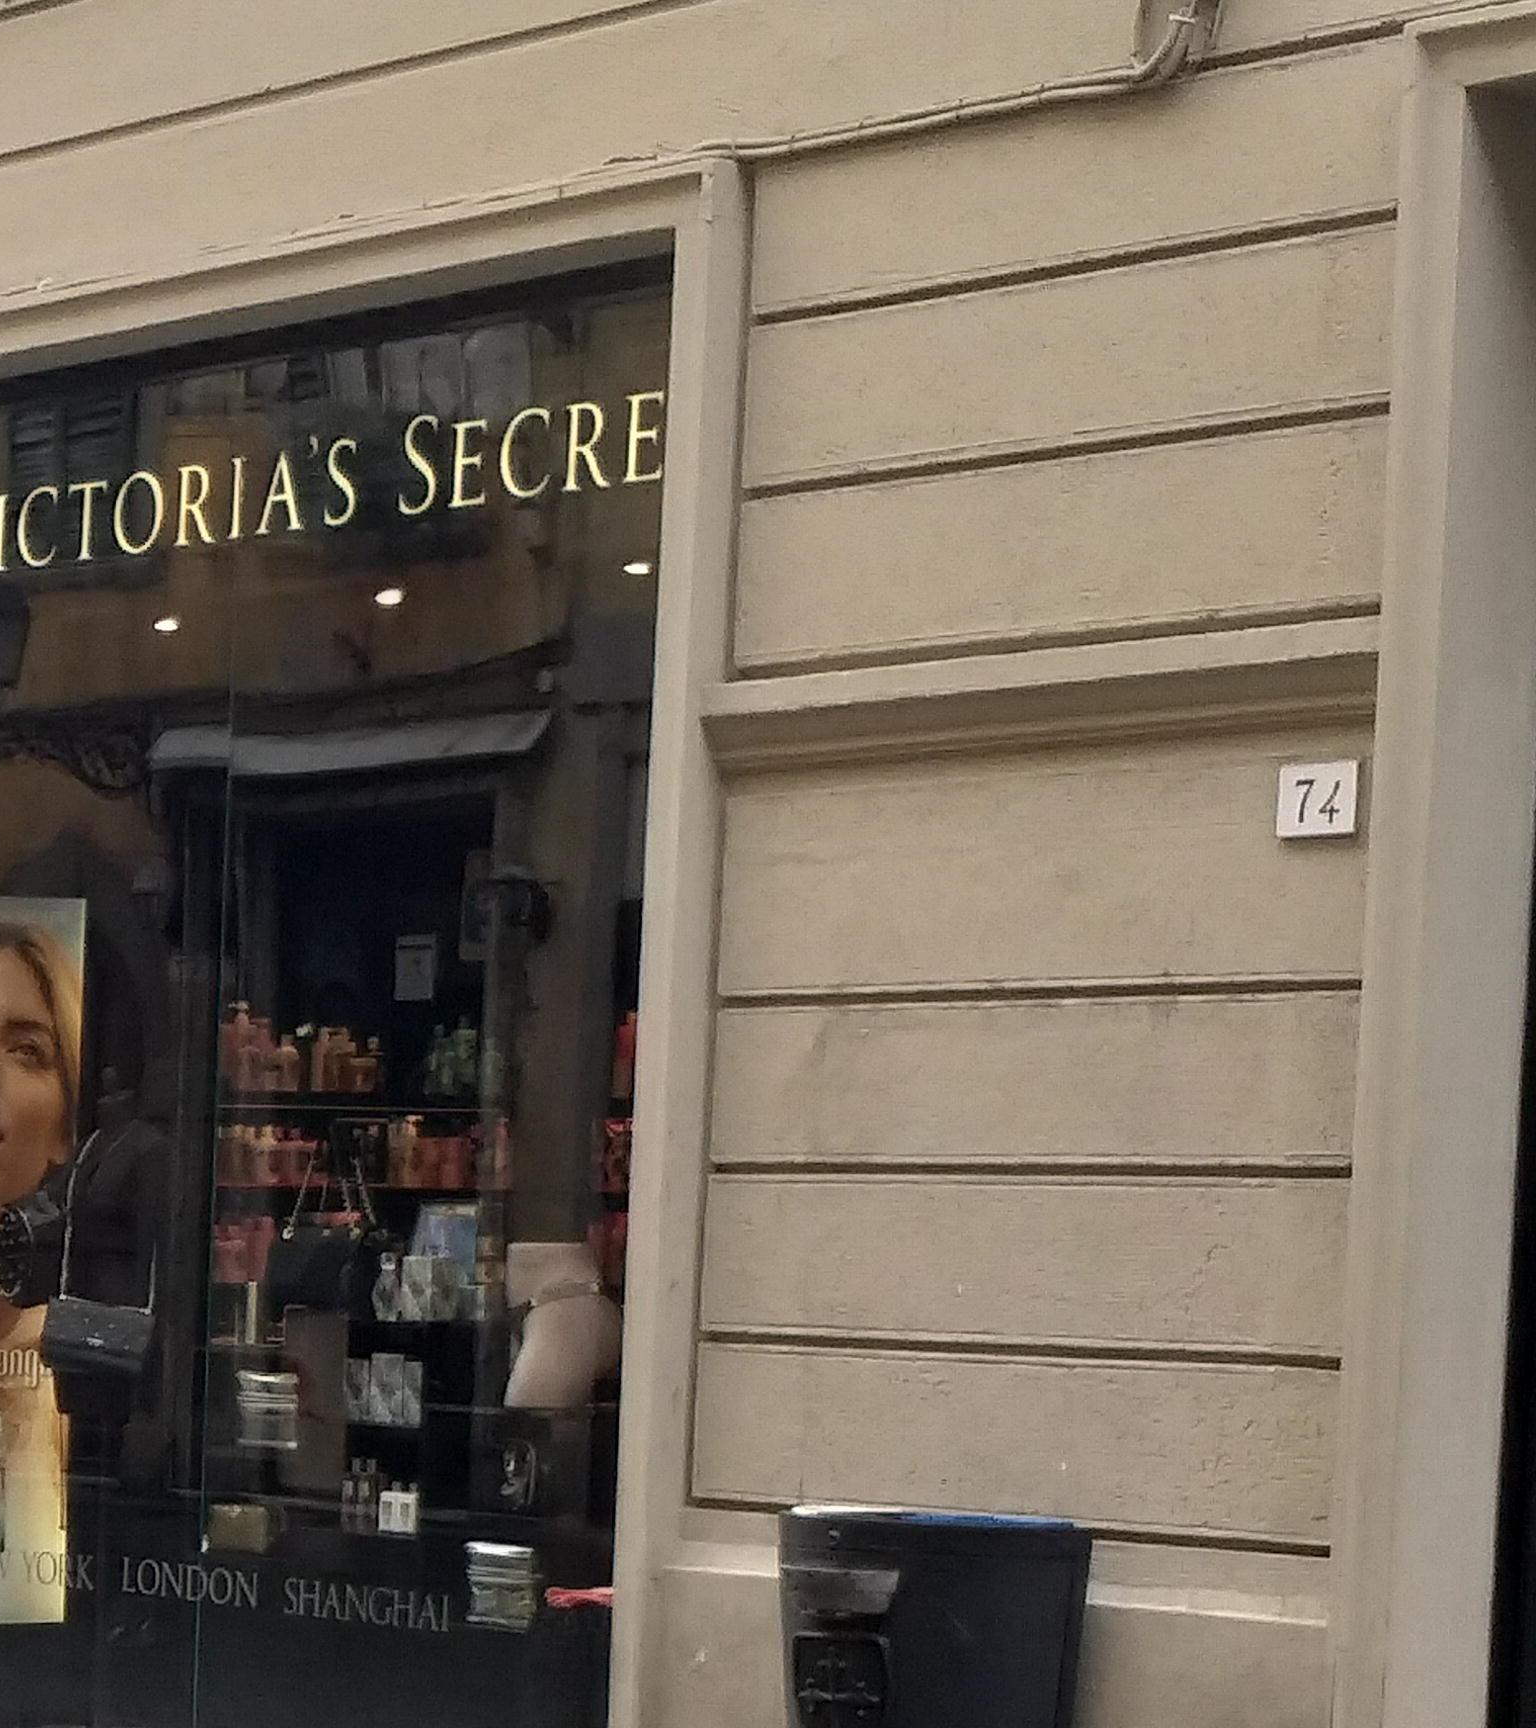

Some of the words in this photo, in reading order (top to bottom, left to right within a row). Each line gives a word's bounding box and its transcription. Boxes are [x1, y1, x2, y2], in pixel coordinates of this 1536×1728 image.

[1295, 779, 1341, 824] 74
[23, 1551, 95, 1592] YORK
[122, 1556, 257, 1609] LONDON
[284, 1576, 450, 1633] SHANGHAI
